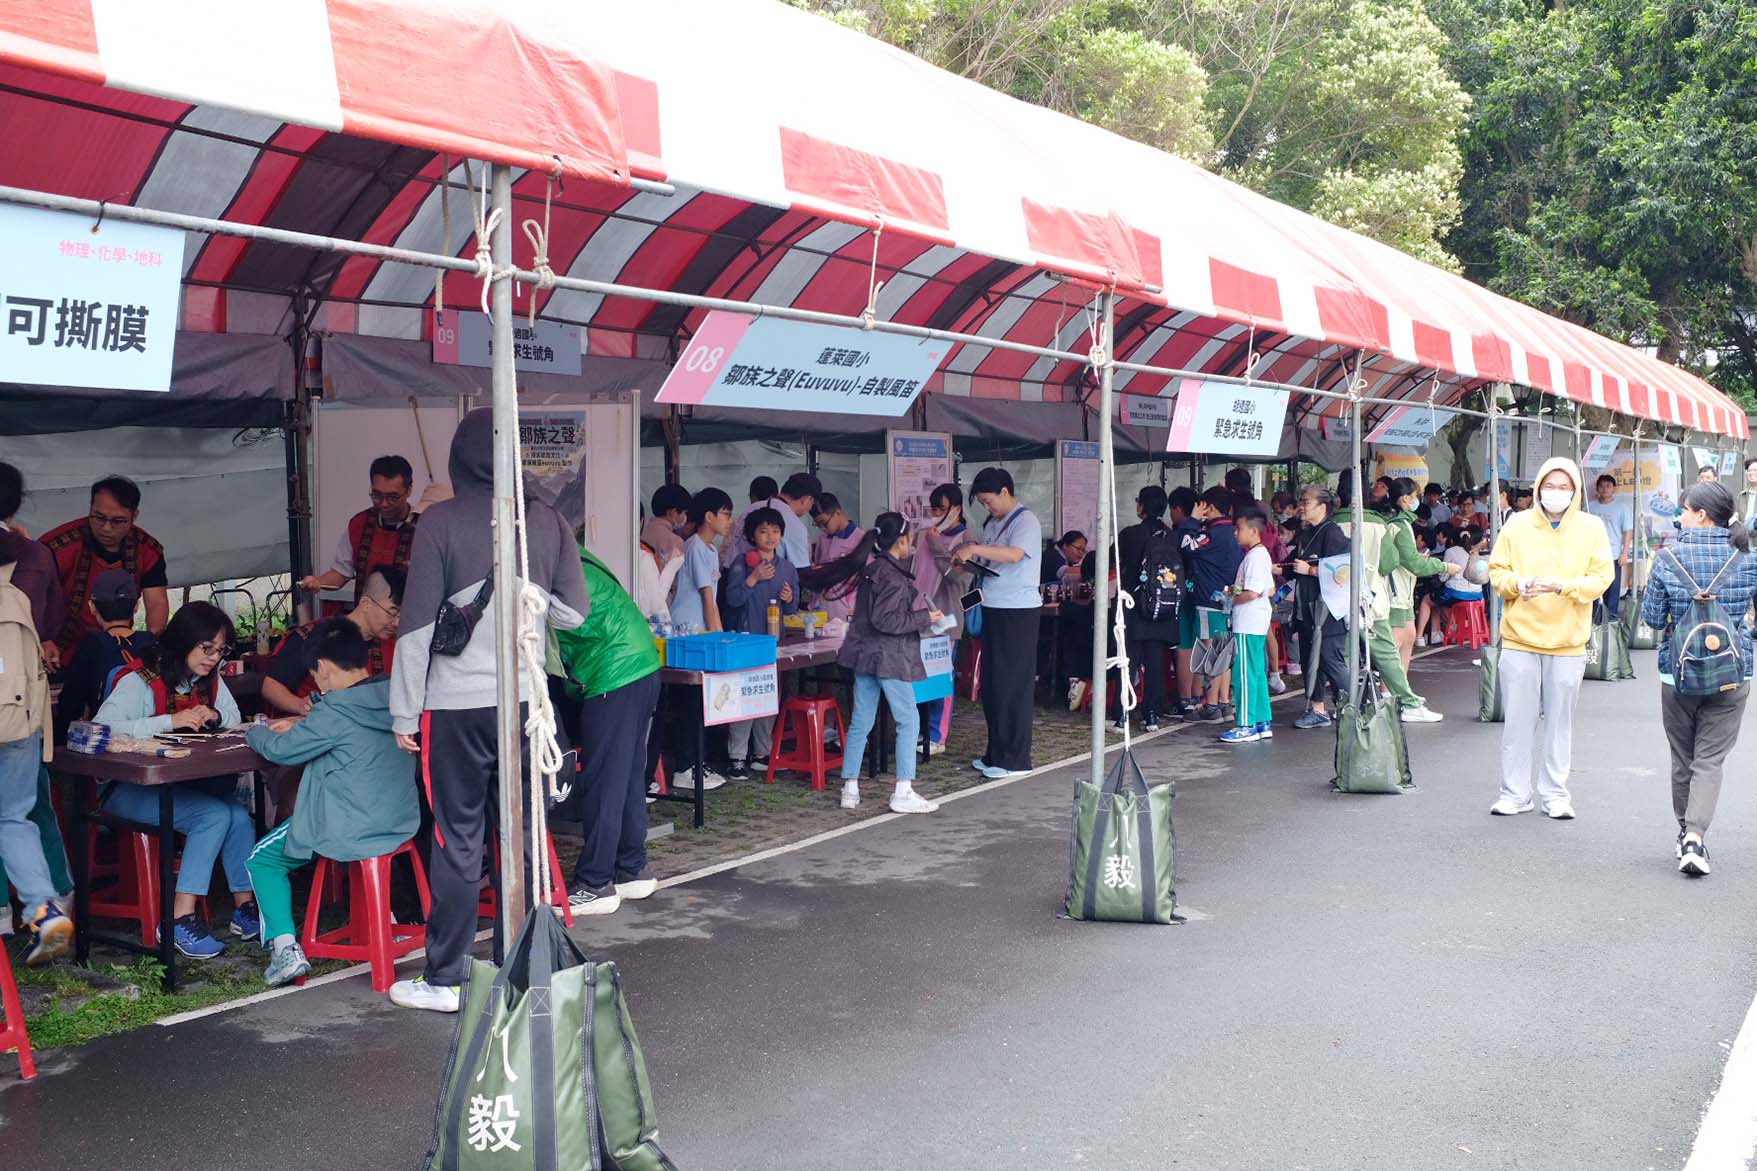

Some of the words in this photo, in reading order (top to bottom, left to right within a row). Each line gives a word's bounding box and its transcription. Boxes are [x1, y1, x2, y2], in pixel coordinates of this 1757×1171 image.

[0, 293, 149, 353] 可撕膜
[438, 328, 455, 344] 09
[685, 346, 725, 373] 08
[815, 347, 870, 368] 蓬萊國小
[1177, 406, 1192, 427] 09
[1213, 418, 1263, 440] 緊急求生號角
